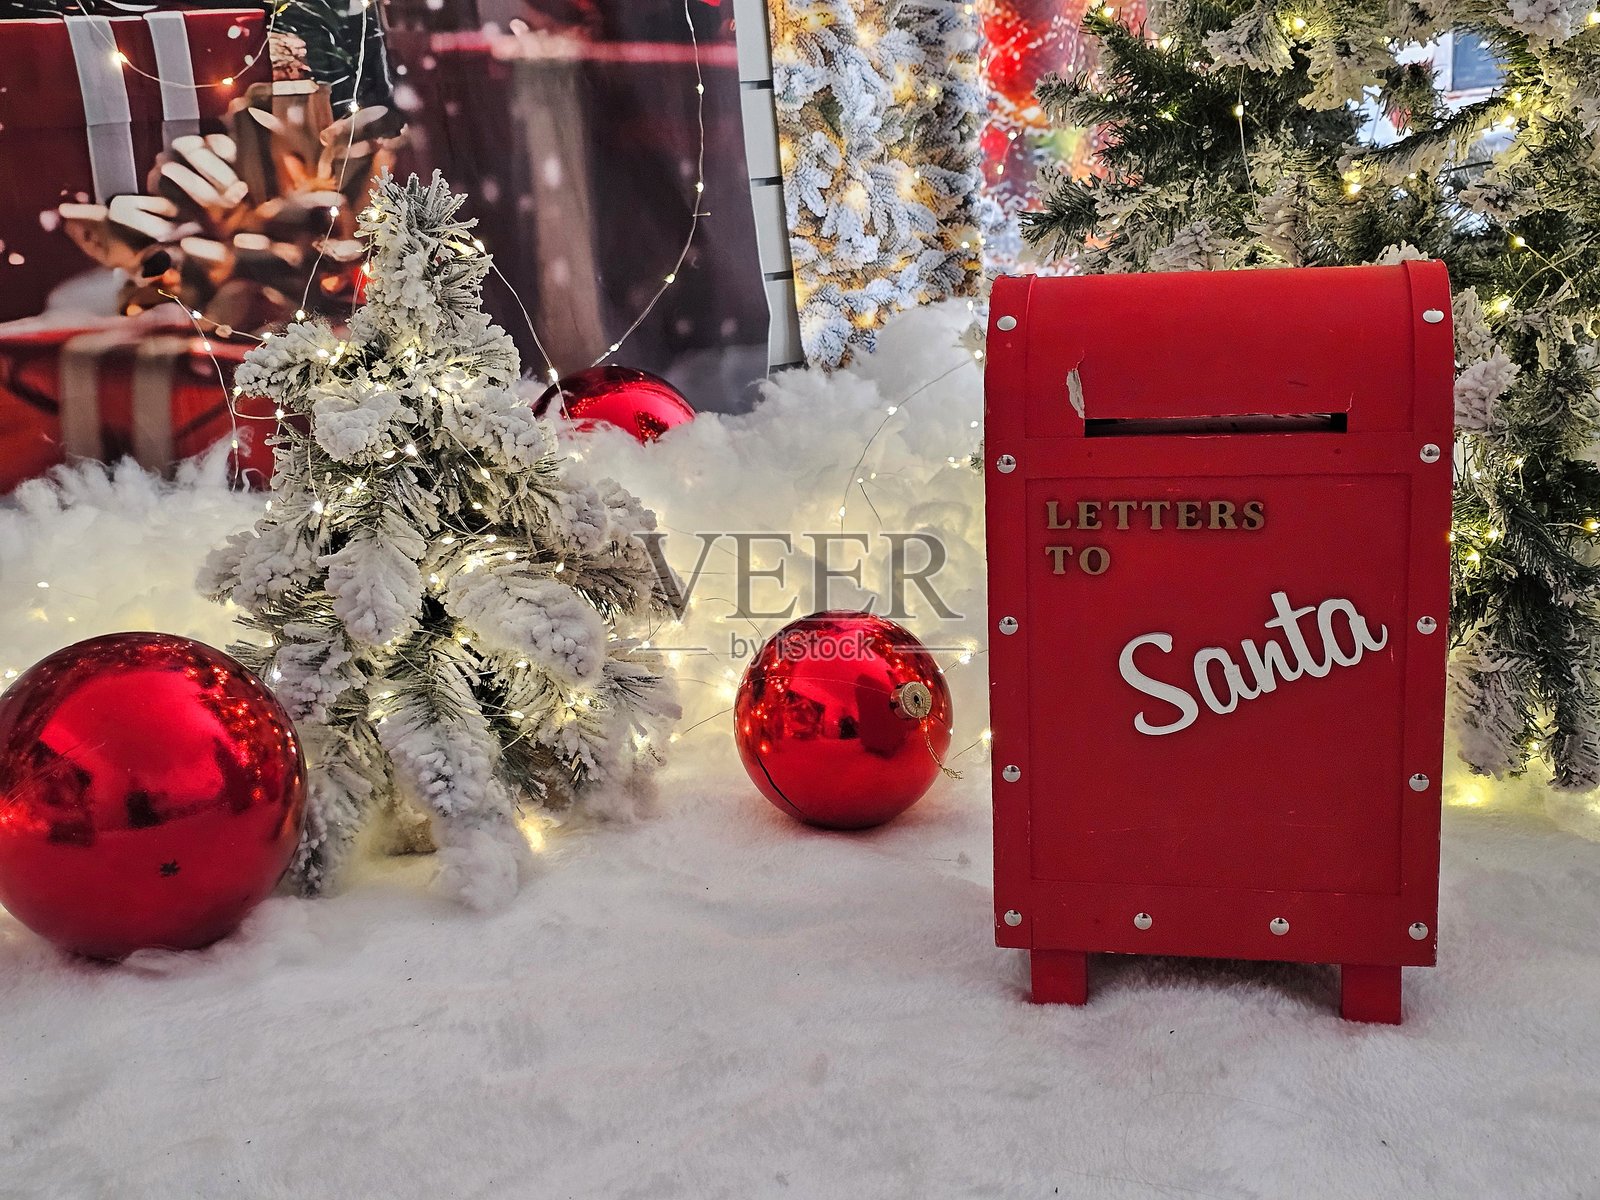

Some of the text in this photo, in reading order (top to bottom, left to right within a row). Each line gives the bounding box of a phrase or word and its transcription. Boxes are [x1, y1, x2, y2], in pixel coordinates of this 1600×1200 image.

[1045, 500, 1265, 530] LETTERS
[1045, 546, 1111, 575] TO
[1118, 591, 1388, 736] Santa
